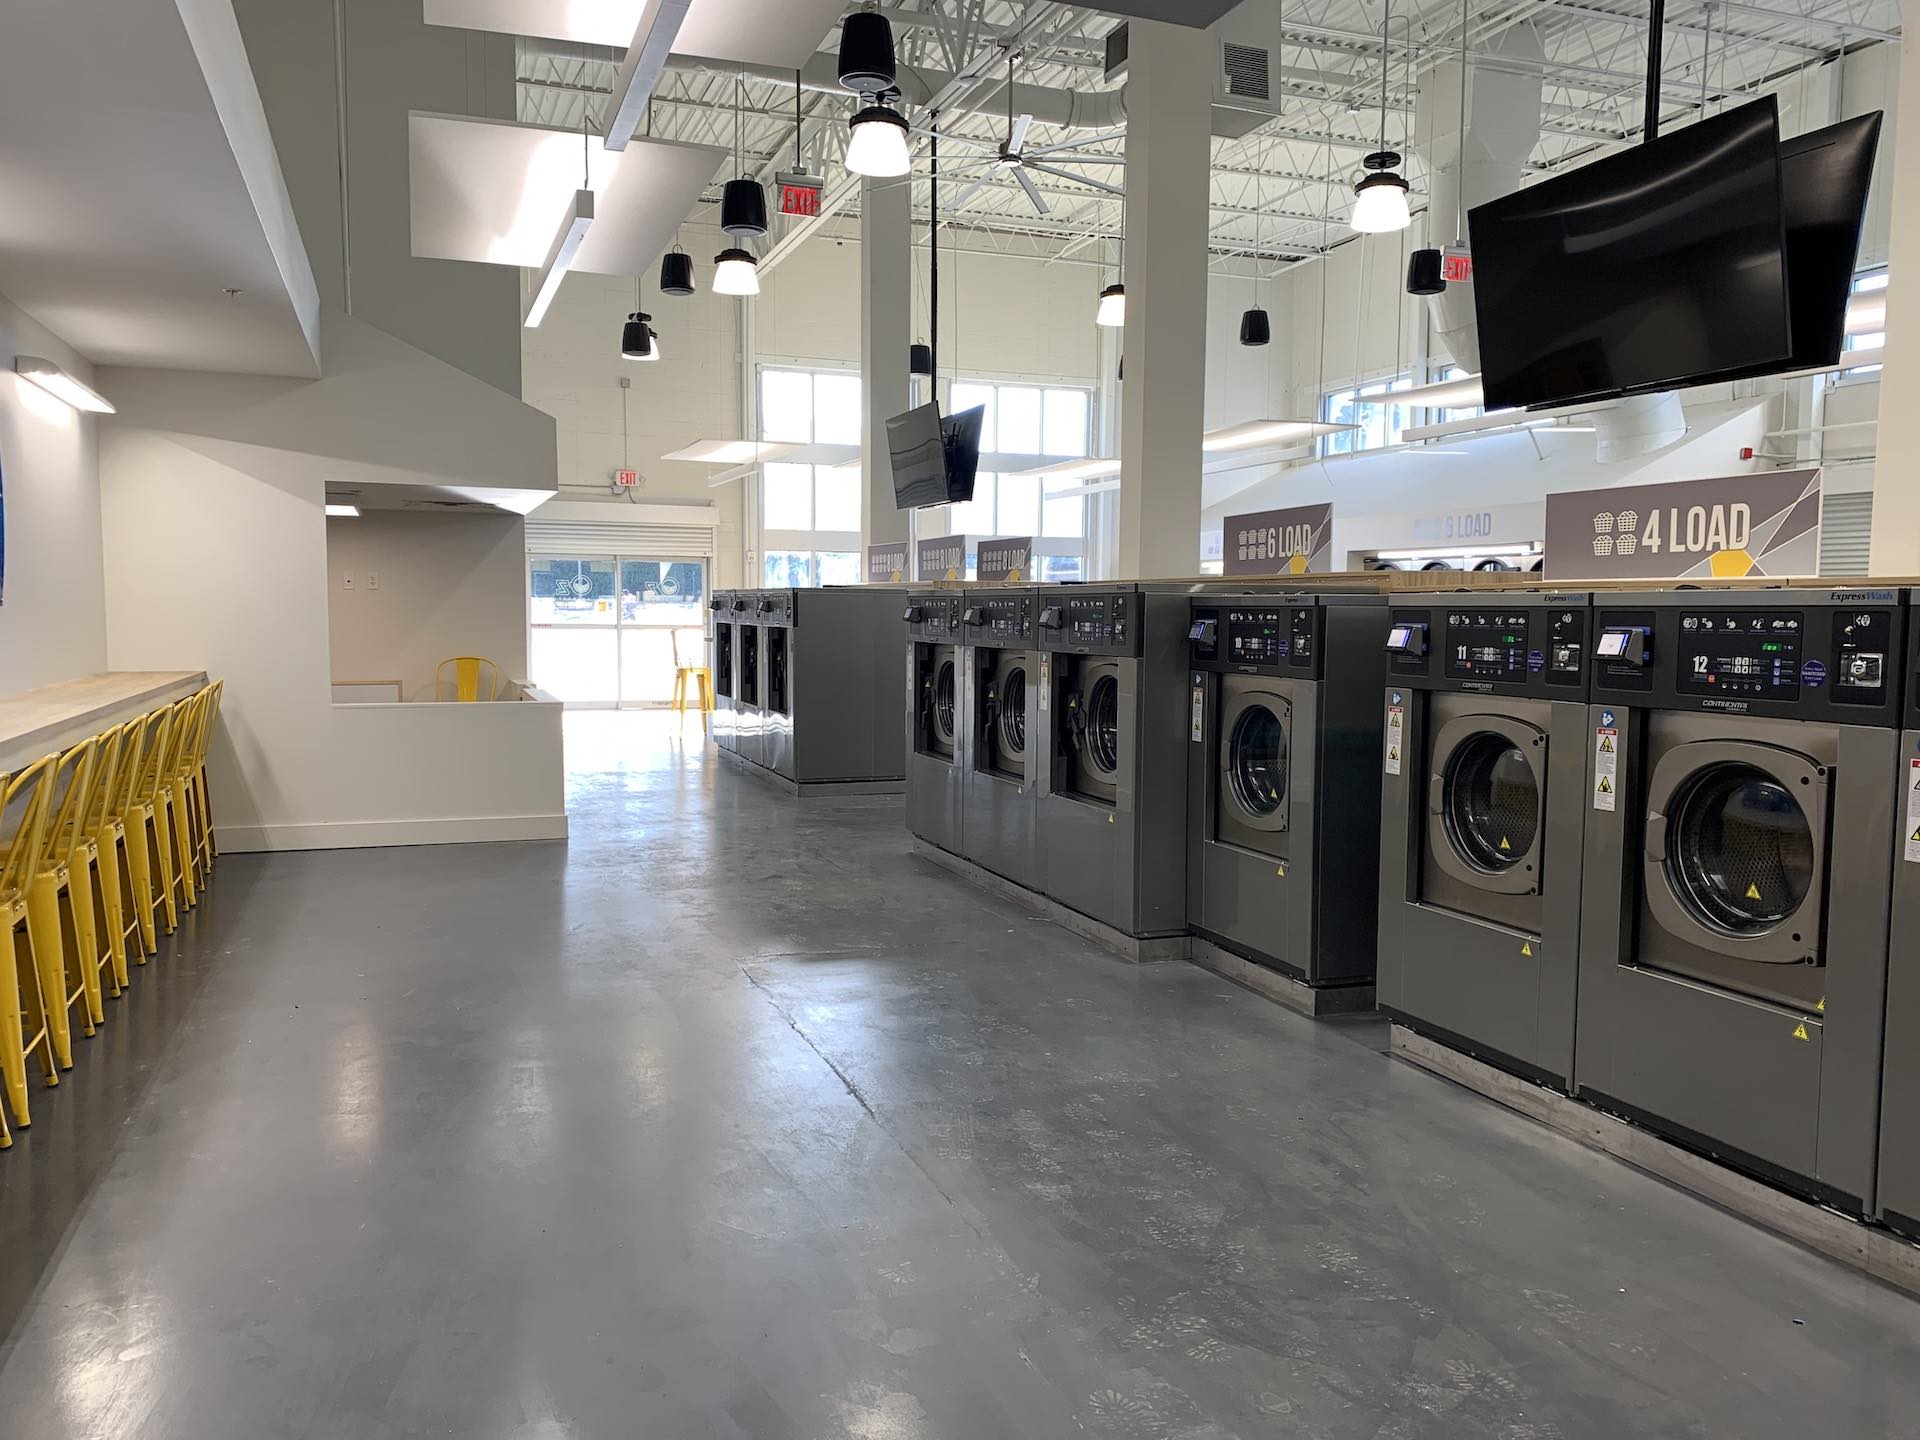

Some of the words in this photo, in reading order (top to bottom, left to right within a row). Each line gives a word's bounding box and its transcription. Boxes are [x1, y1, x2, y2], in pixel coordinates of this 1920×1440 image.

[783, 187, 817, 215] EXIT
[620, 472, 636, 485] EXIT
[1457, 512, 1492, 538] LOAD
[1642, 509, 1661, 553] 4
[1669, 503, 1750, 553] LOAD
[1267, 528, 1276, 558] 6
[1278, 524, 1311, 557] LOAD
[945, 548, 960, 568] LOAD
[1008, 549, 1025, 569] LOAD
[1831, 591, 1893, 603] ExpressWash
[1457, 645, 1467, 660] 11
[1693, 655, 1708, 673] 12
